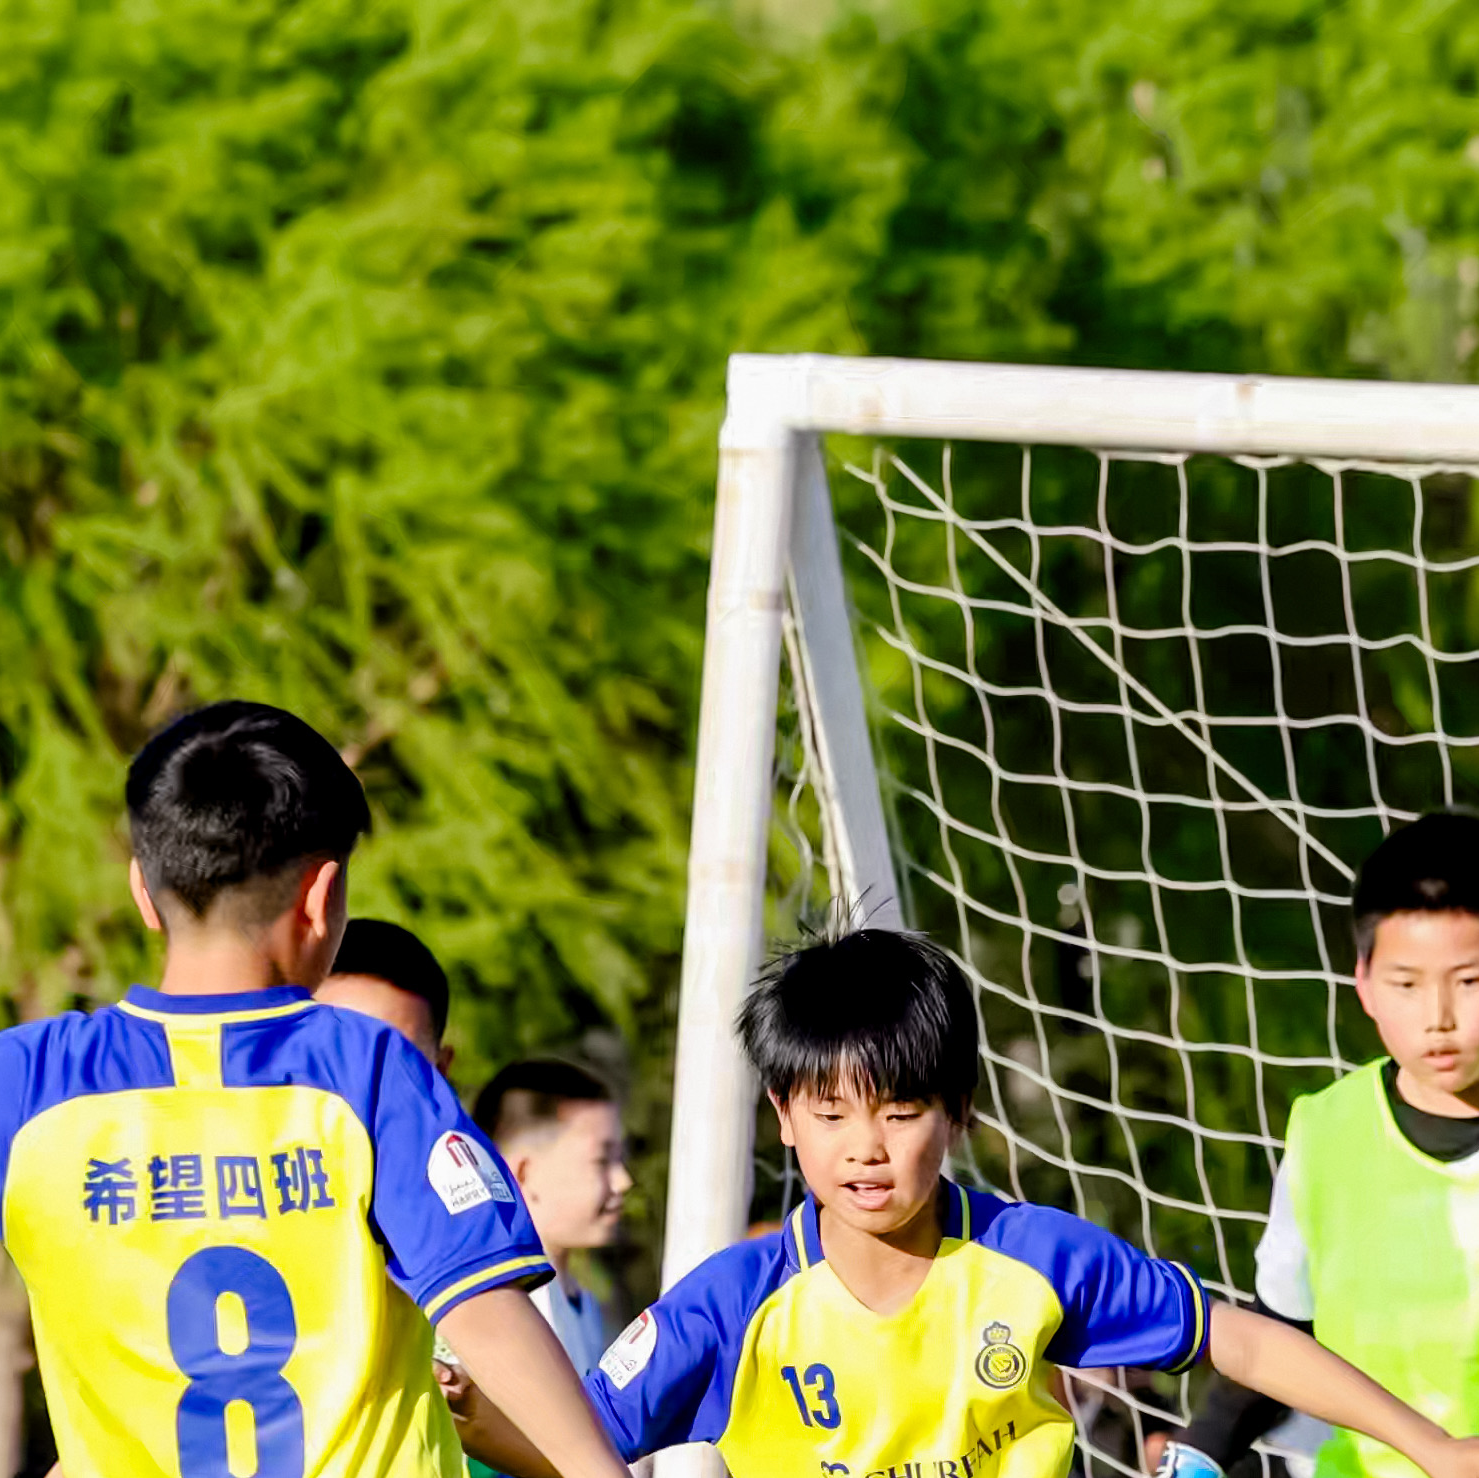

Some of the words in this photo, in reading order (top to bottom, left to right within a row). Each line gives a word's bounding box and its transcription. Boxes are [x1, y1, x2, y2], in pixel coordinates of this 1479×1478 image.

[82, 1146, 336, 1226] 希望四班
[781, 1361, 842, 1430] 13
